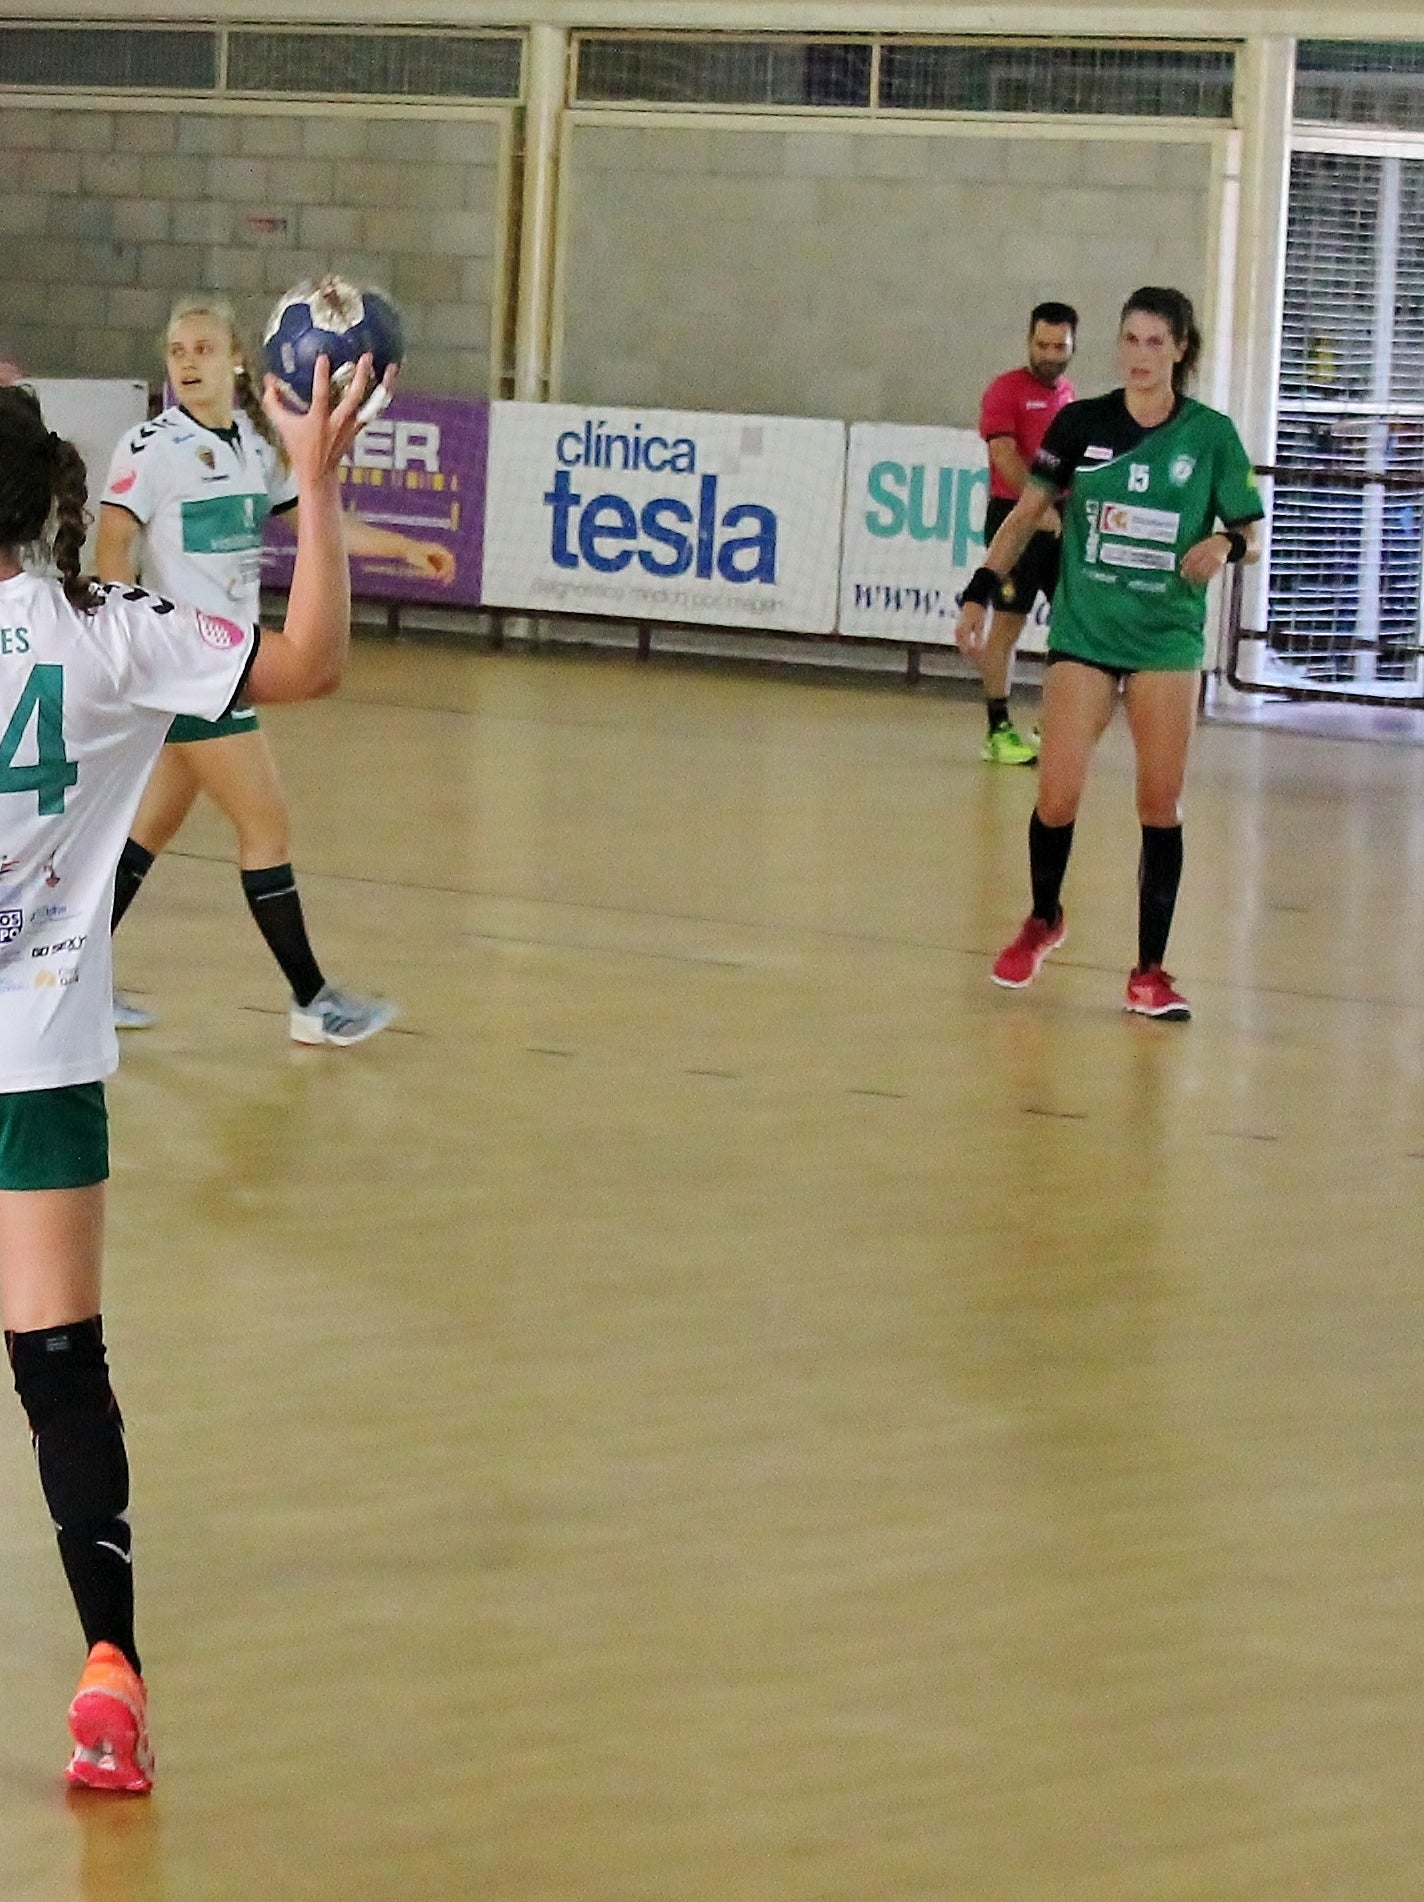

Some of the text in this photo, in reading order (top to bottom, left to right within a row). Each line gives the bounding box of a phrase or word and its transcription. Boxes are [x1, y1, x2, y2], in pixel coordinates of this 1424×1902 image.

[340, 419, 441, 473] ER
[556, 420, 697, 474] clínica
[544, 470, 777, 584] tesla
